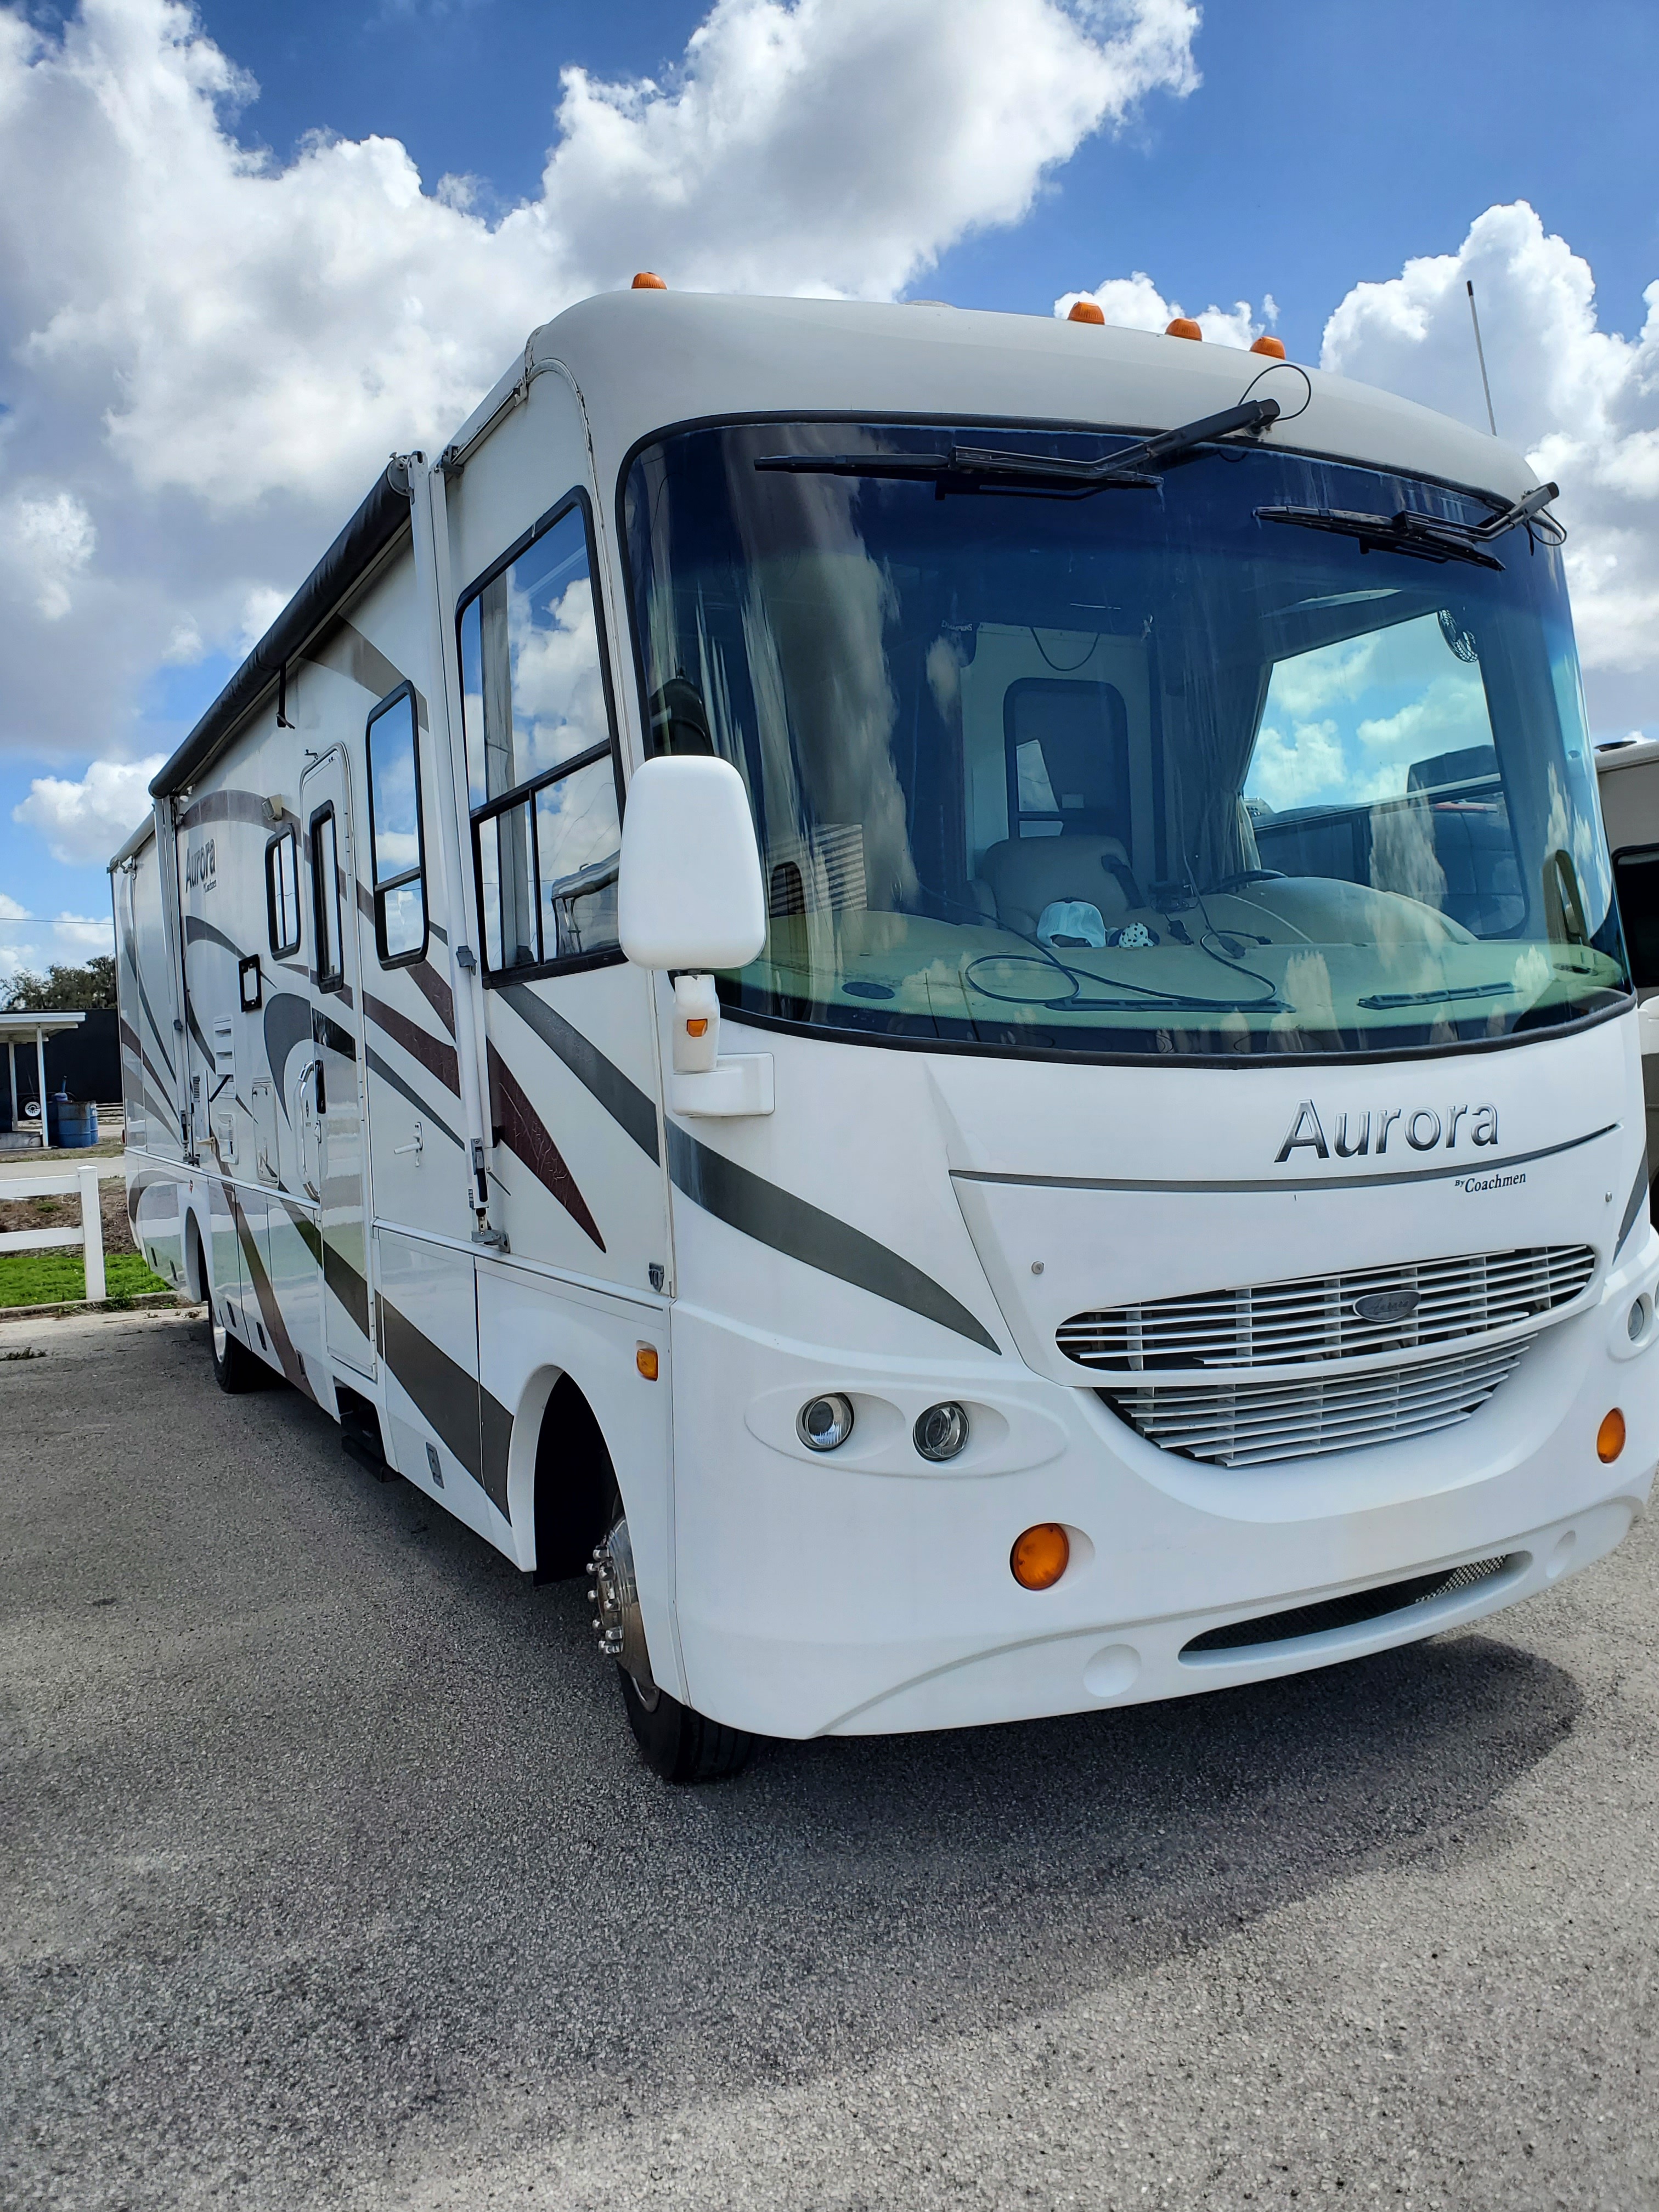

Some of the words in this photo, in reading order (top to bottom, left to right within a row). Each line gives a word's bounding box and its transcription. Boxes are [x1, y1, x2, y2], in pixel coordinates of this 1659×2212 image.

[186, 838, 215, 893] Aurora
[1274, 1098, 1498, 1163] Aurora
[1465, 1173, 1526, 1193] Coachmen
